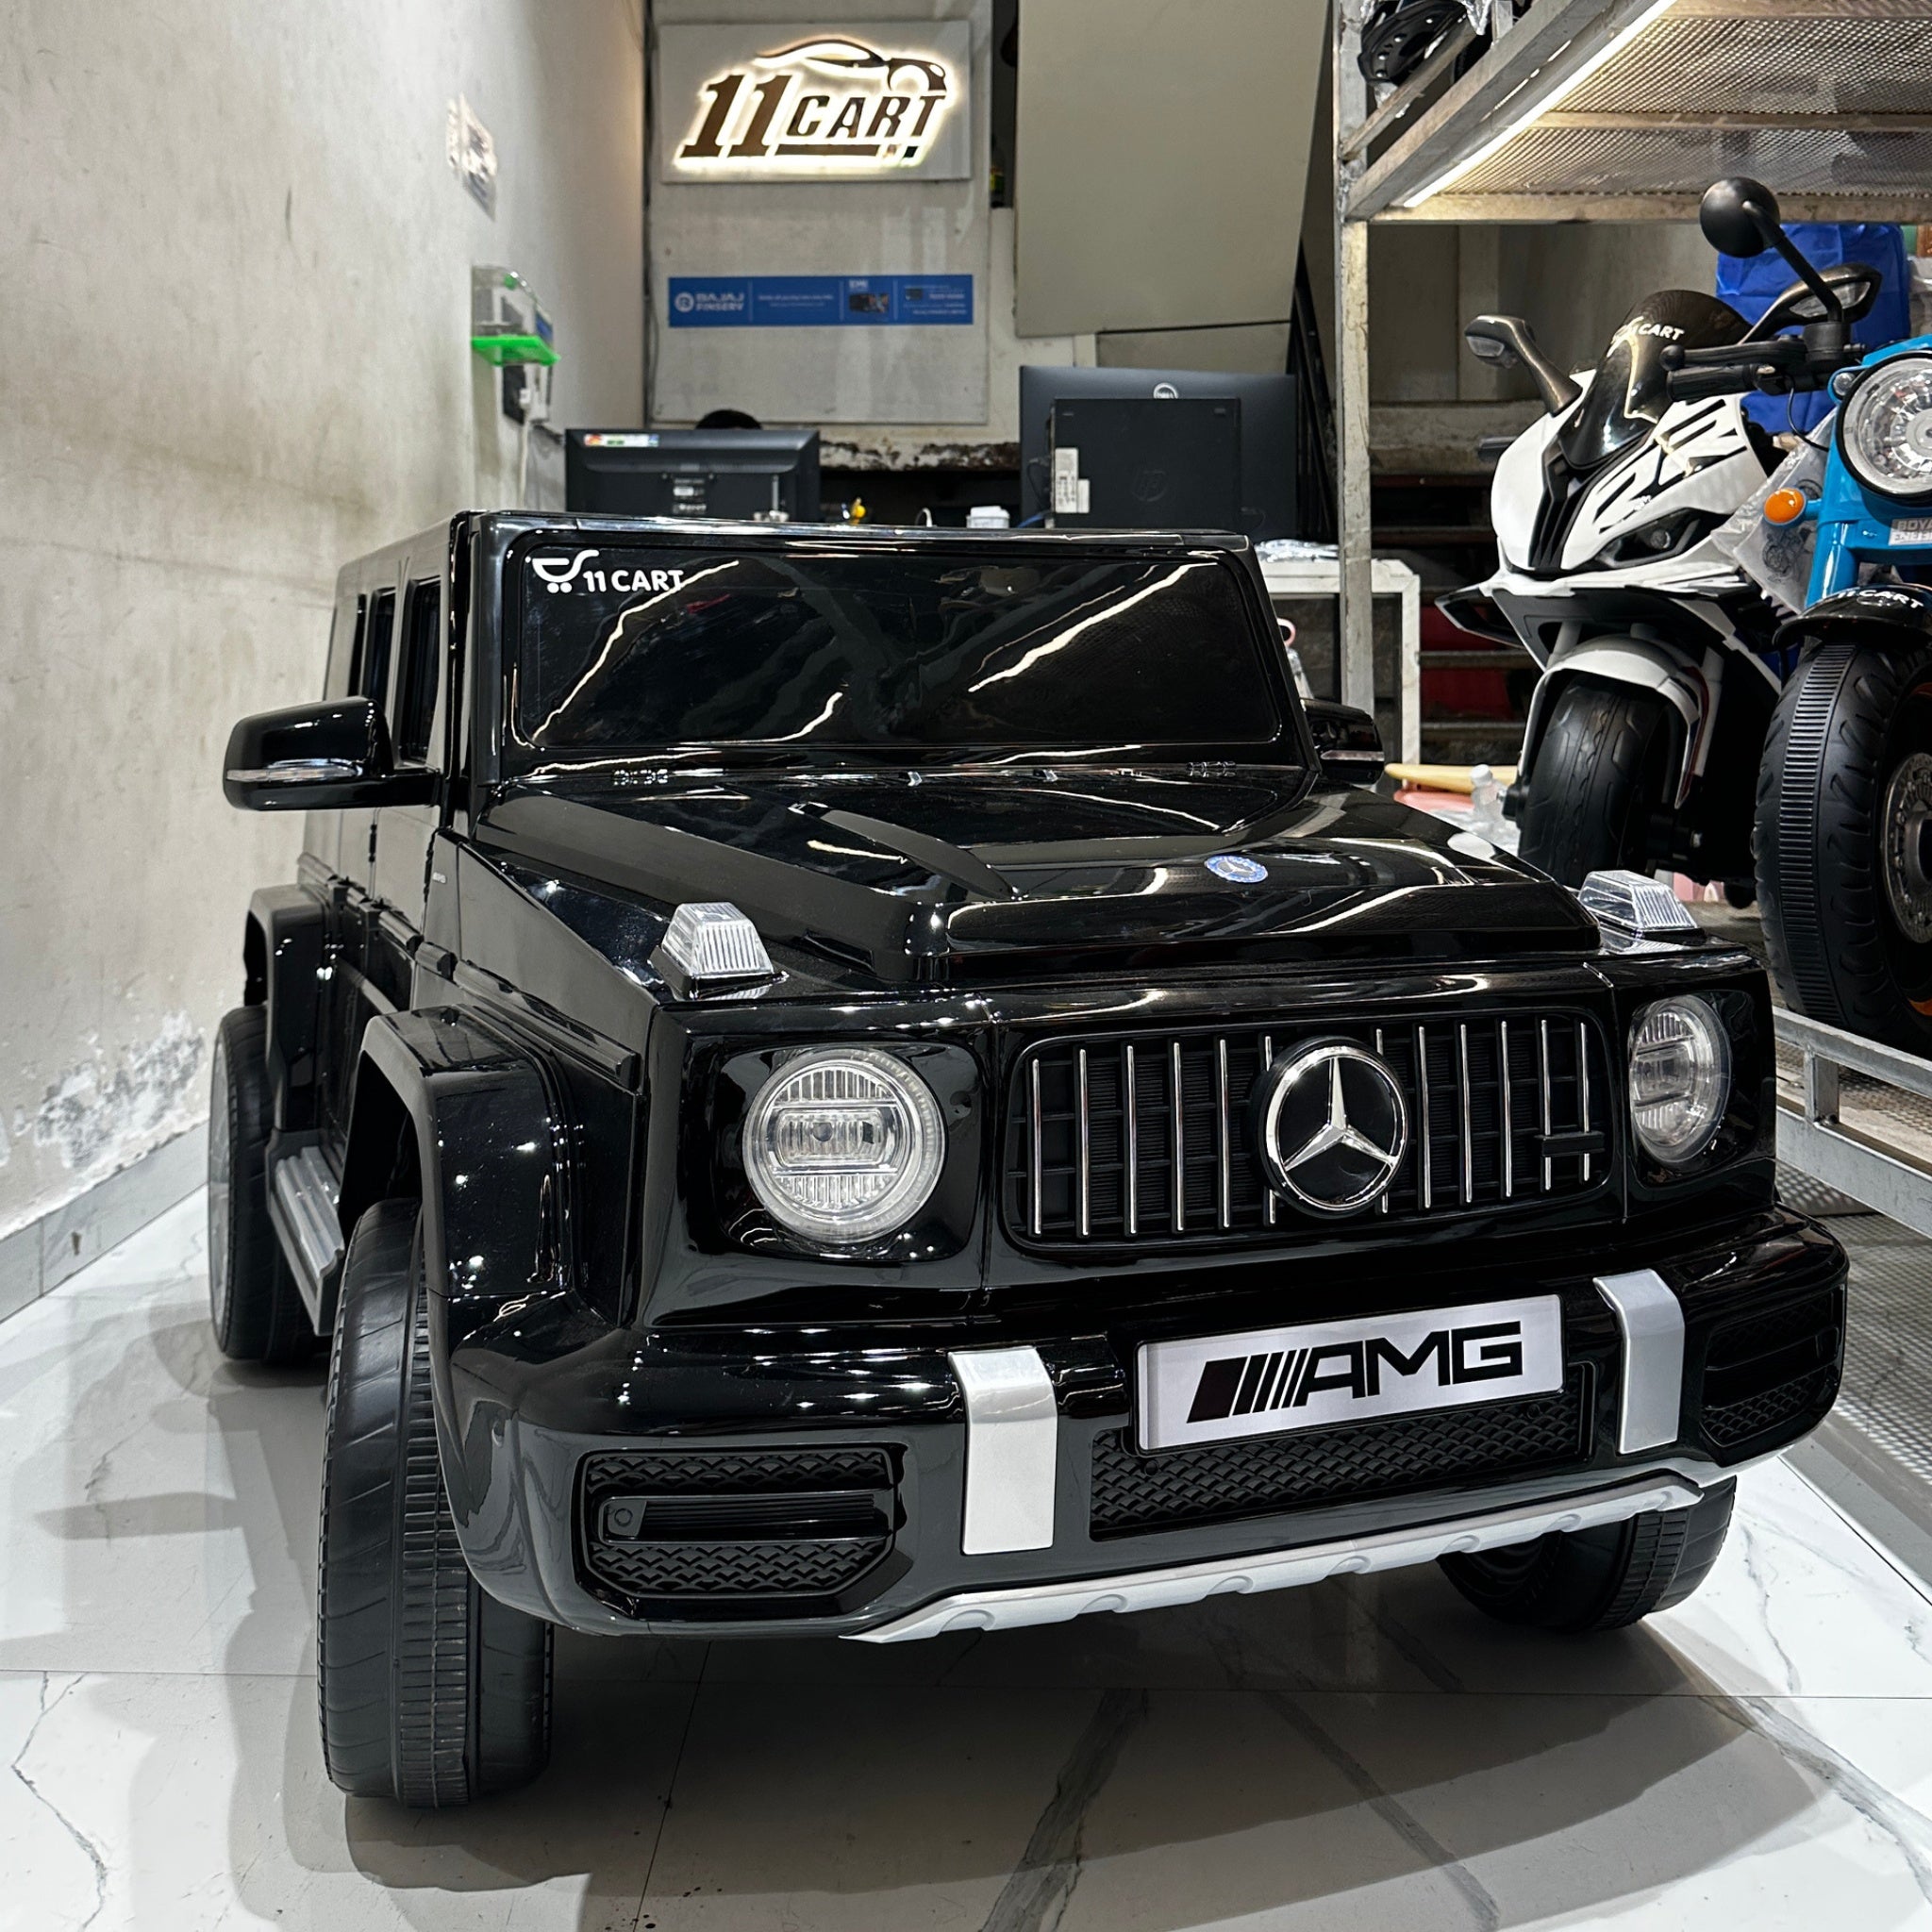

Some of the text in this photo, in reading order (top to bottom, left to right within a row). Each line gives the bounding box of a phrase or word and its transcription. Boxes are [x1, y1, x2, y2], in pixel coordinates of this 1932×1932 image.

[680, 74, 948, 158] 11 CART
[1638, 323, 1686, 341] CART
[583, 569, 685, 592] 11 CART
[1858, 589, 1925, 609] CART
[1292, 1320, 1524, 1407] AMG
